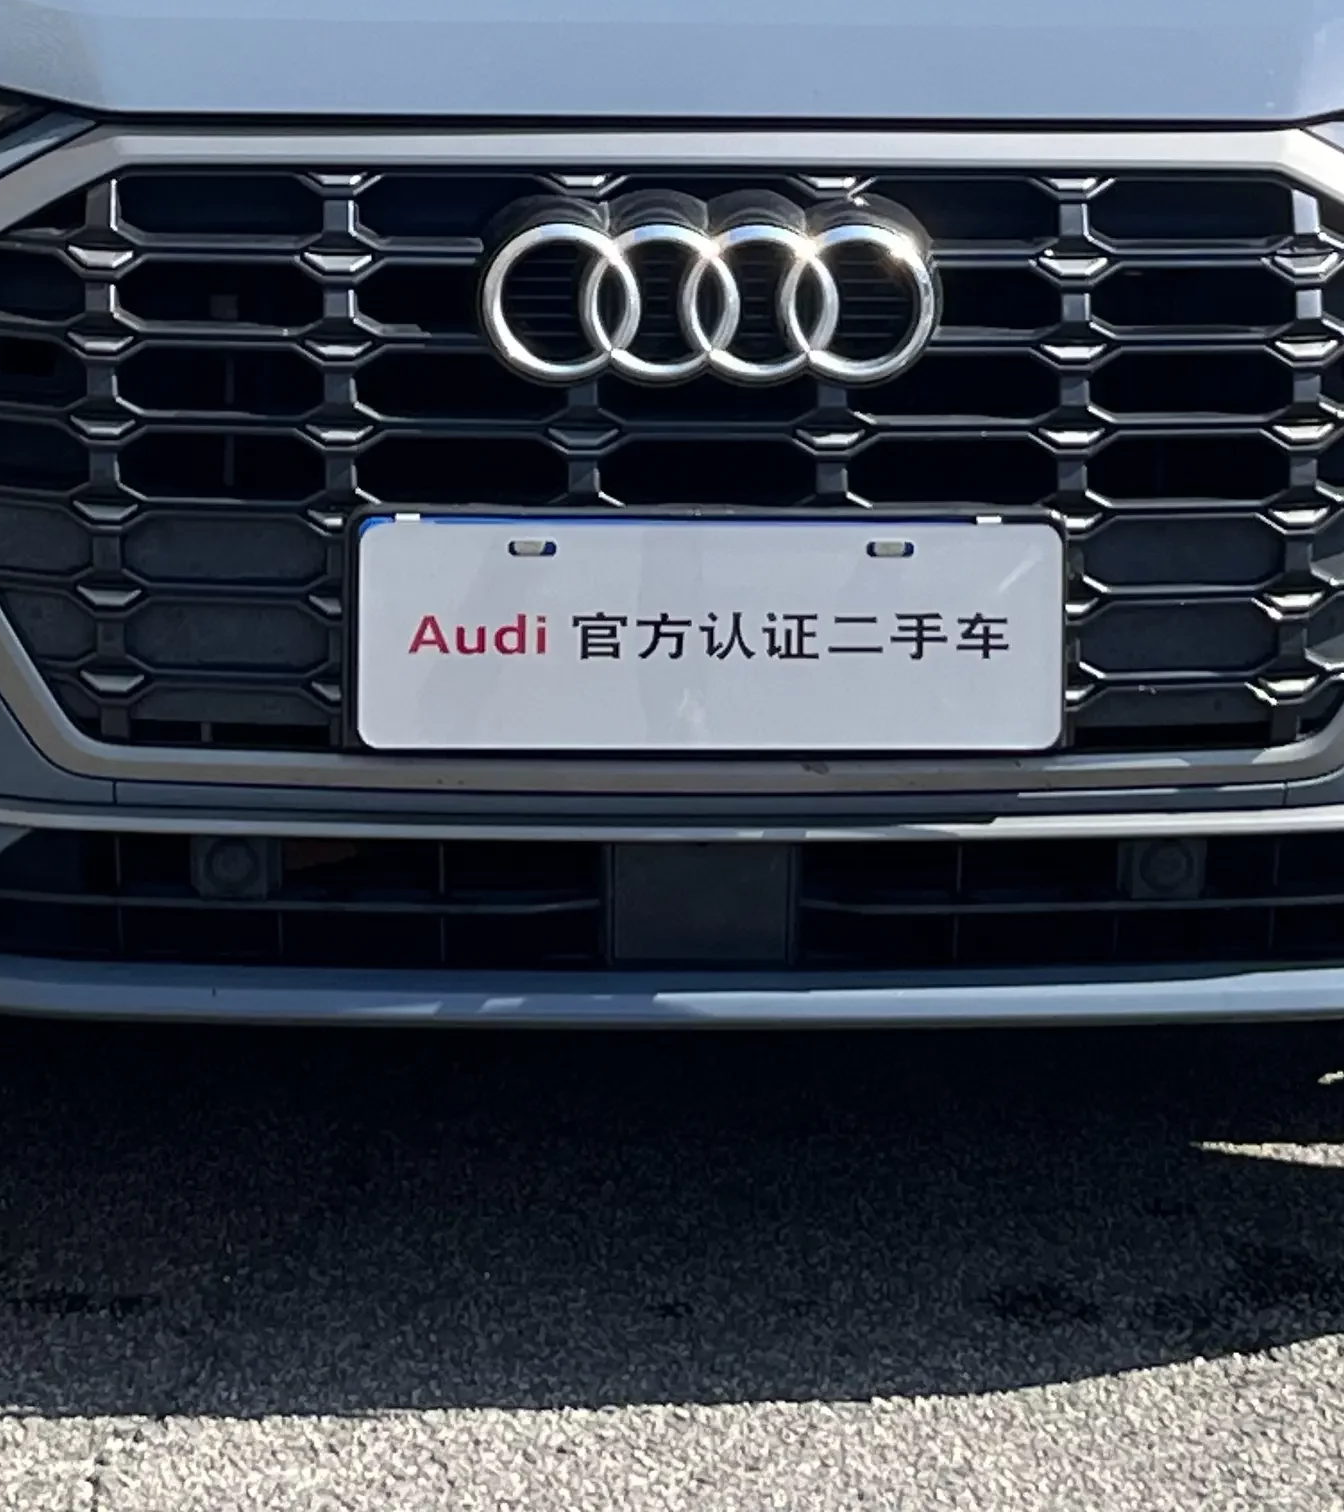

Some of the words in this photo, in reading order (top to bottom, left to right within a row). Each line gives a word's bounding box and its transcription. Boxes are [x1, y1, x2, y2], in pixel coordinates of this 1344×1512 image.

[408, 614, 548, 655] Audi
[572, 612, 1011, 660] 官方认证二手车
